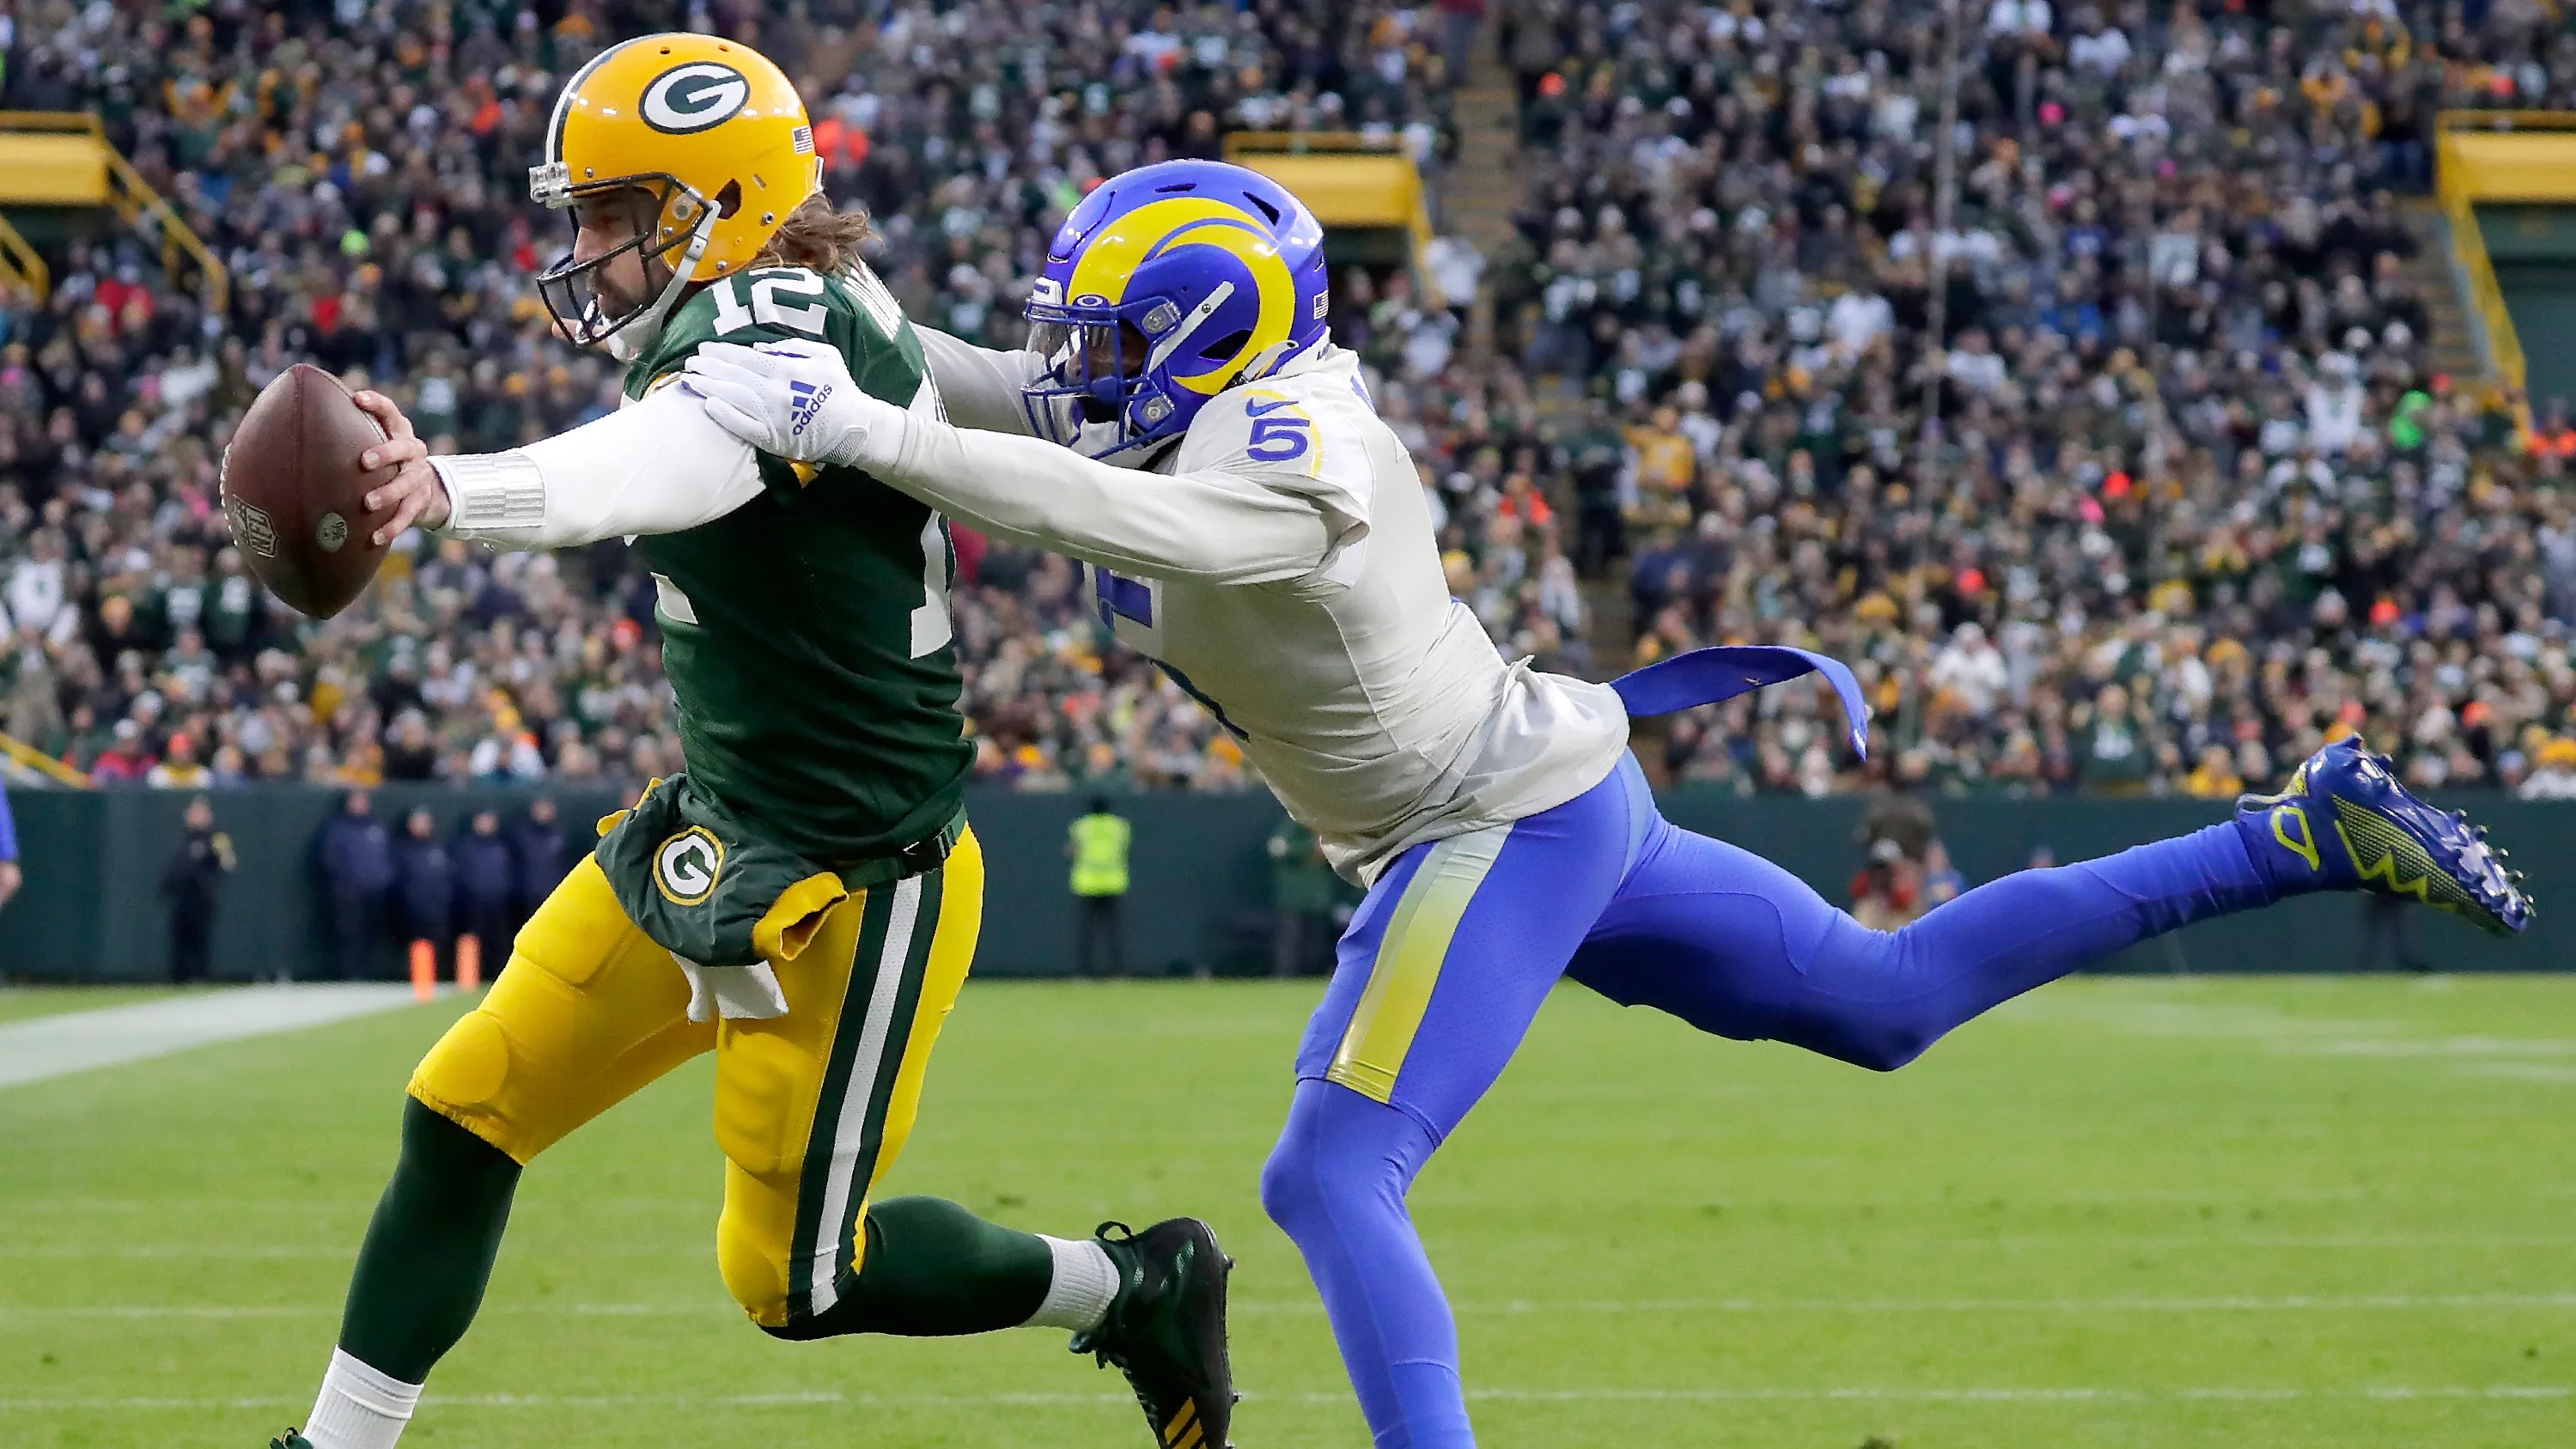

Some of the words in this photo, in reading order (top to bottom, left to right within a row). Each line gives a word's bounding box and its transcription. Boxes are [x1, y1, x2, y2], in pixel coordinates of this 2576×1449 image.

[643, 64, 746, 129] G
[704, 266, 829, 337] 12
[792, 383, 832, 435] adidas
[1246, 417, 1310, 461] 5
[661, 834, 716, 895] G
